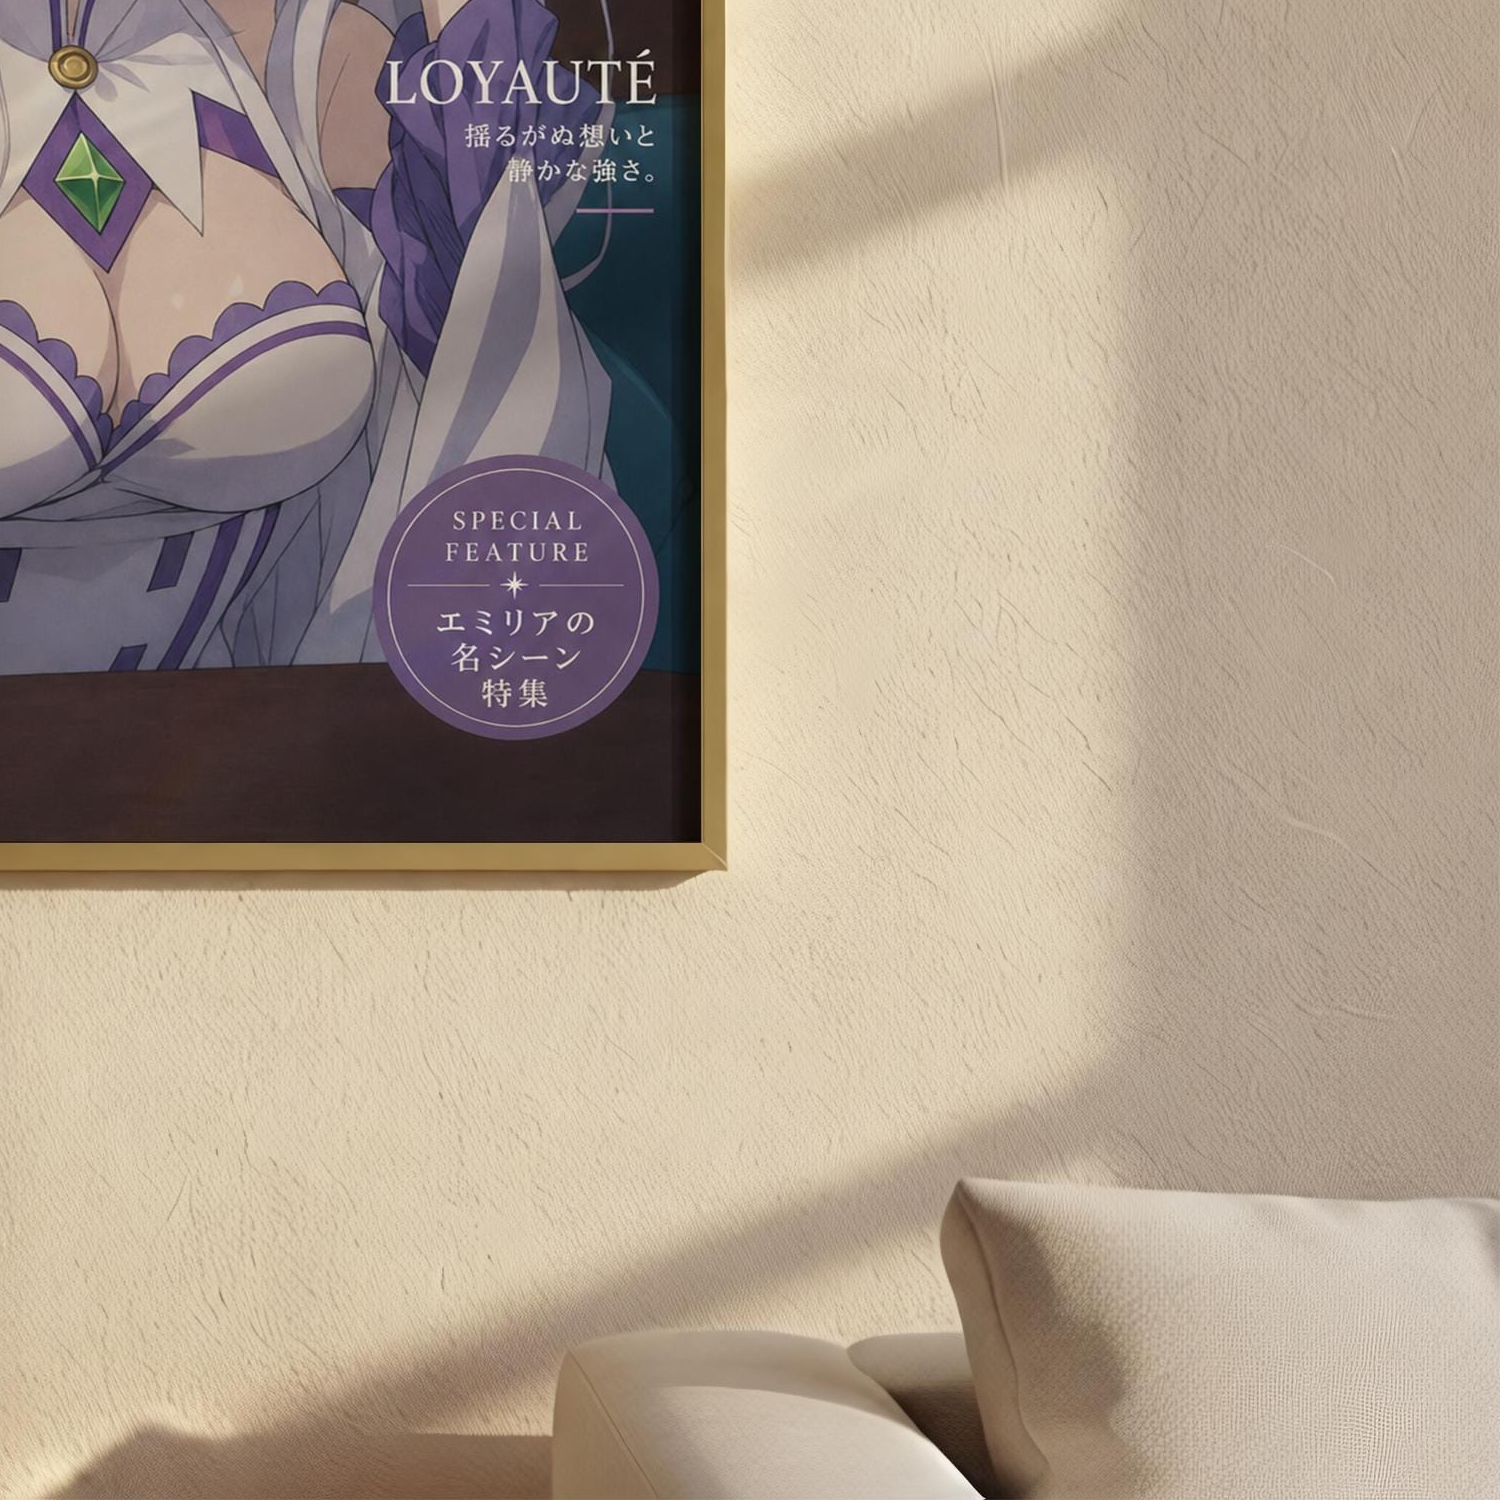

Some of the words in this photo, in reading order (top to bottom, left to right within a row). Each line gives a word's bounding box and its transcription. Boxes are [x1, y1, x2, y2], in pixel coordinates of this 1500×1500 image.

[385, 48, 658, 106] LOYAUTÉ
[463, 123, 655, 149] 揺るがぬ想いと
[507, 158, 655, 183] 静かな強さ。
[452, 510, 583, 531] SPECIAL
[445, 542, 589, 563] FEATURE
[435, 609, 595, 637] エミリアの
[450, 642, 581, 673] 名シーン
[481, 678, 549, 708] 特集
